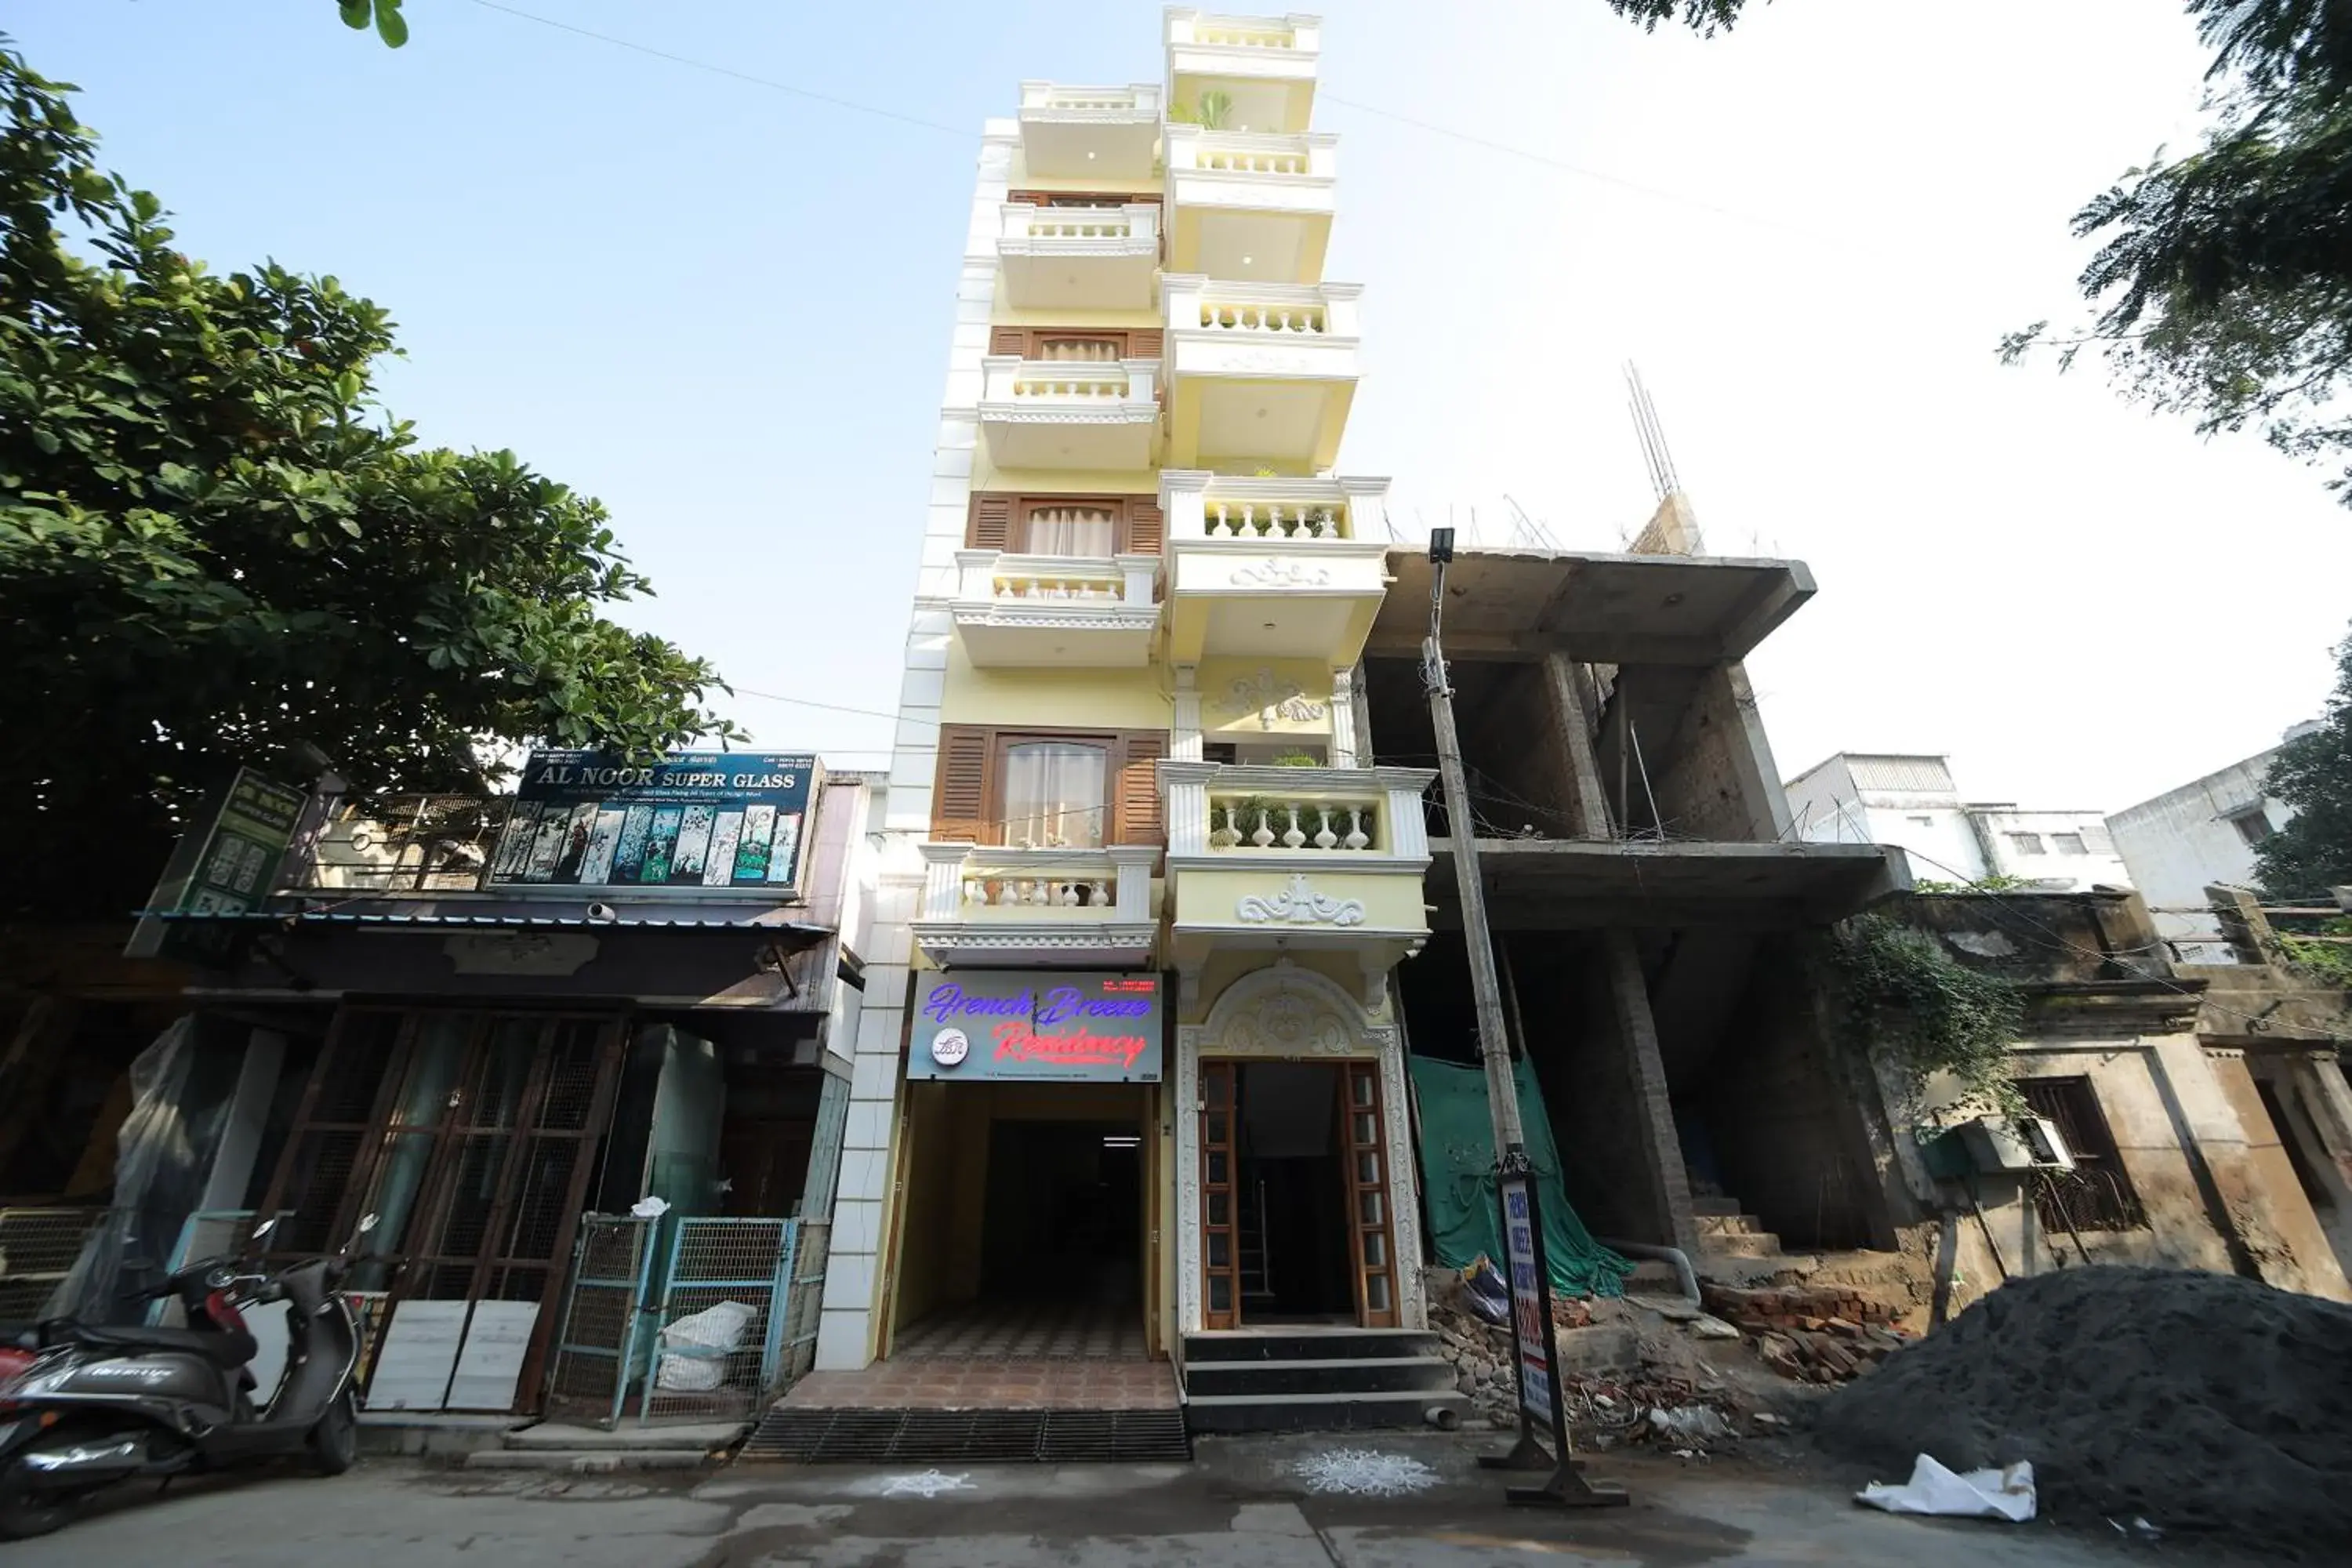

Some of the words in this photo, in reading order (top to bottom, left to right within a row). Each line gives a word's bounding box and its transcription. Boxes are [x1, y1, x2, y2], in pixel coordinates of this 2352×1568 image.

[536, 766, 573, 784] AL
[579, 767, 655, 786] NOOR
[662, 772, 727, 787] SUPER
[732, 774, 795, 789] GLASS
[924, 983, 1033, 1023] French
[1036, 986, 1151, 1025] Breeze
[992, 1021, 1146, 1069] Residency
